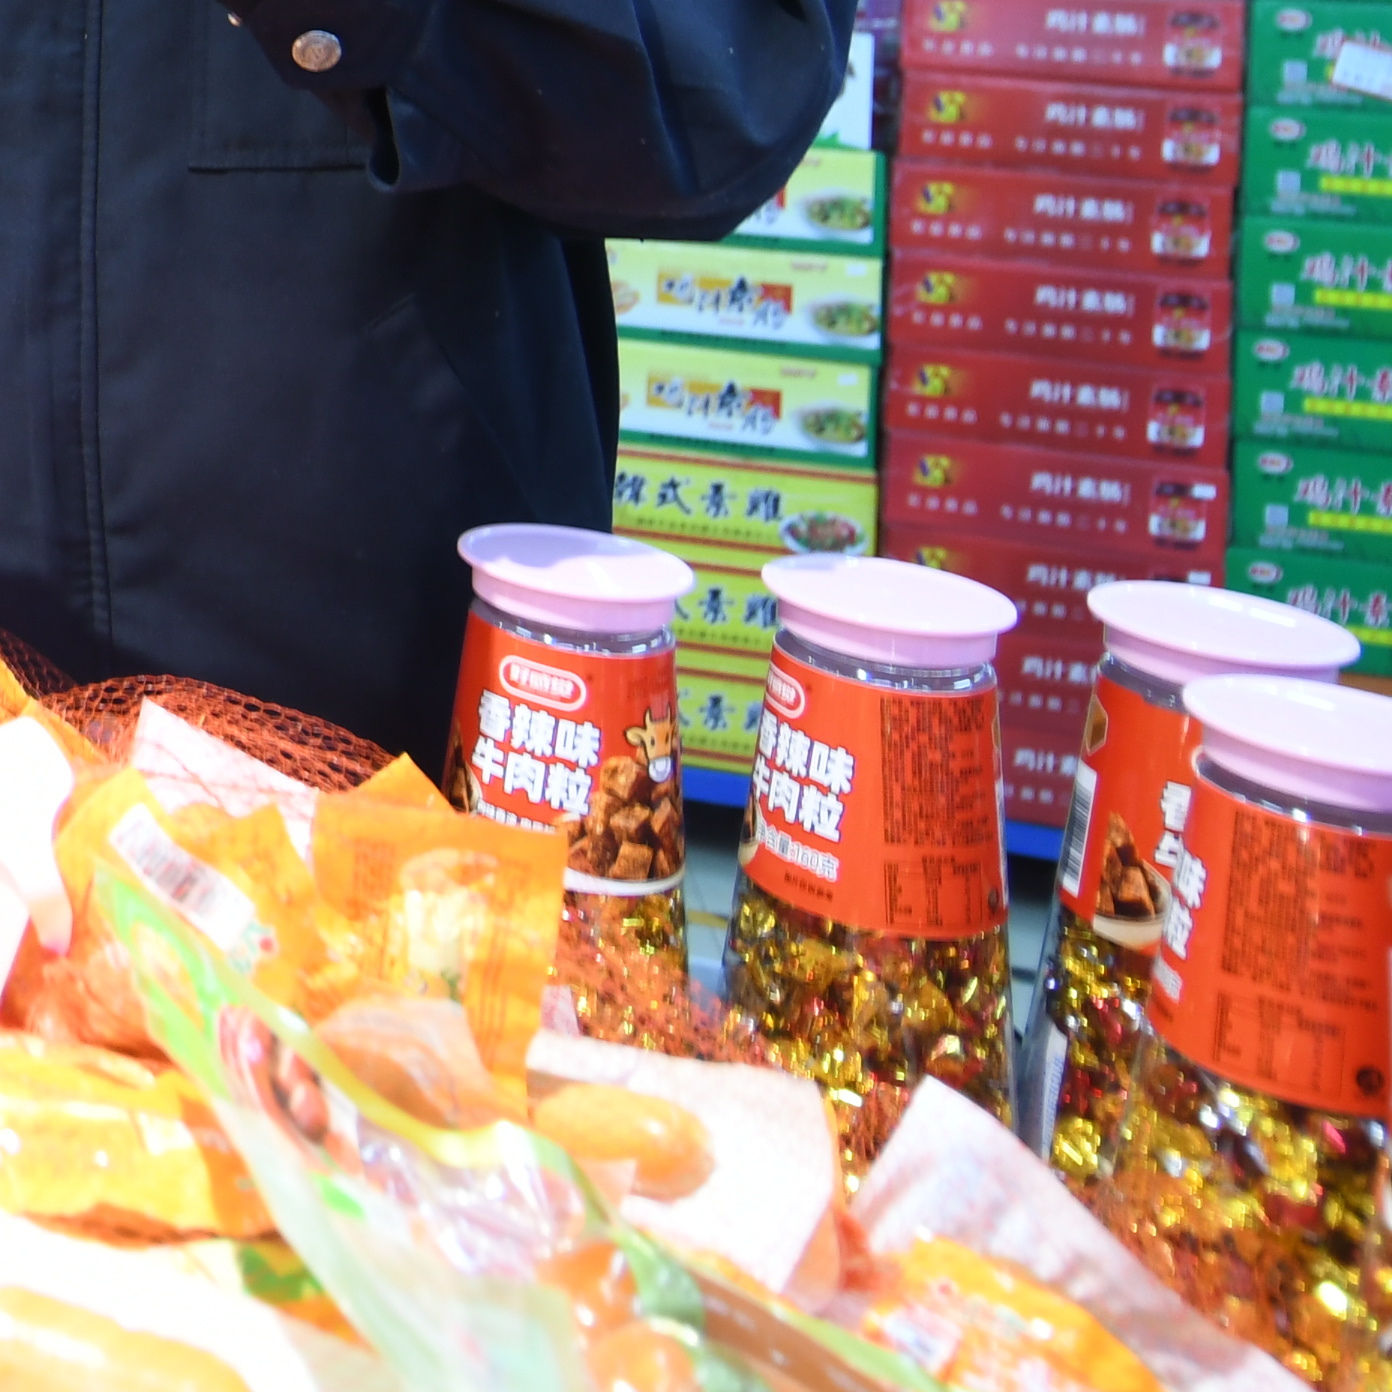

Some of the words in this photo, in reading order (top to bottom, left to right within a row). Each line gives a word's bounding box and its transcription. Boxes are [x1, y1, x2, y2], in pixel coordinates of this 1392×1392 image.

[478, 689, 601, 768] 香辣味
[759, 708, 855, 795] 香辣味
[472, 735, 592, 816] 牛肉粒
[752, 754, 845, 843] 牛肉粒
